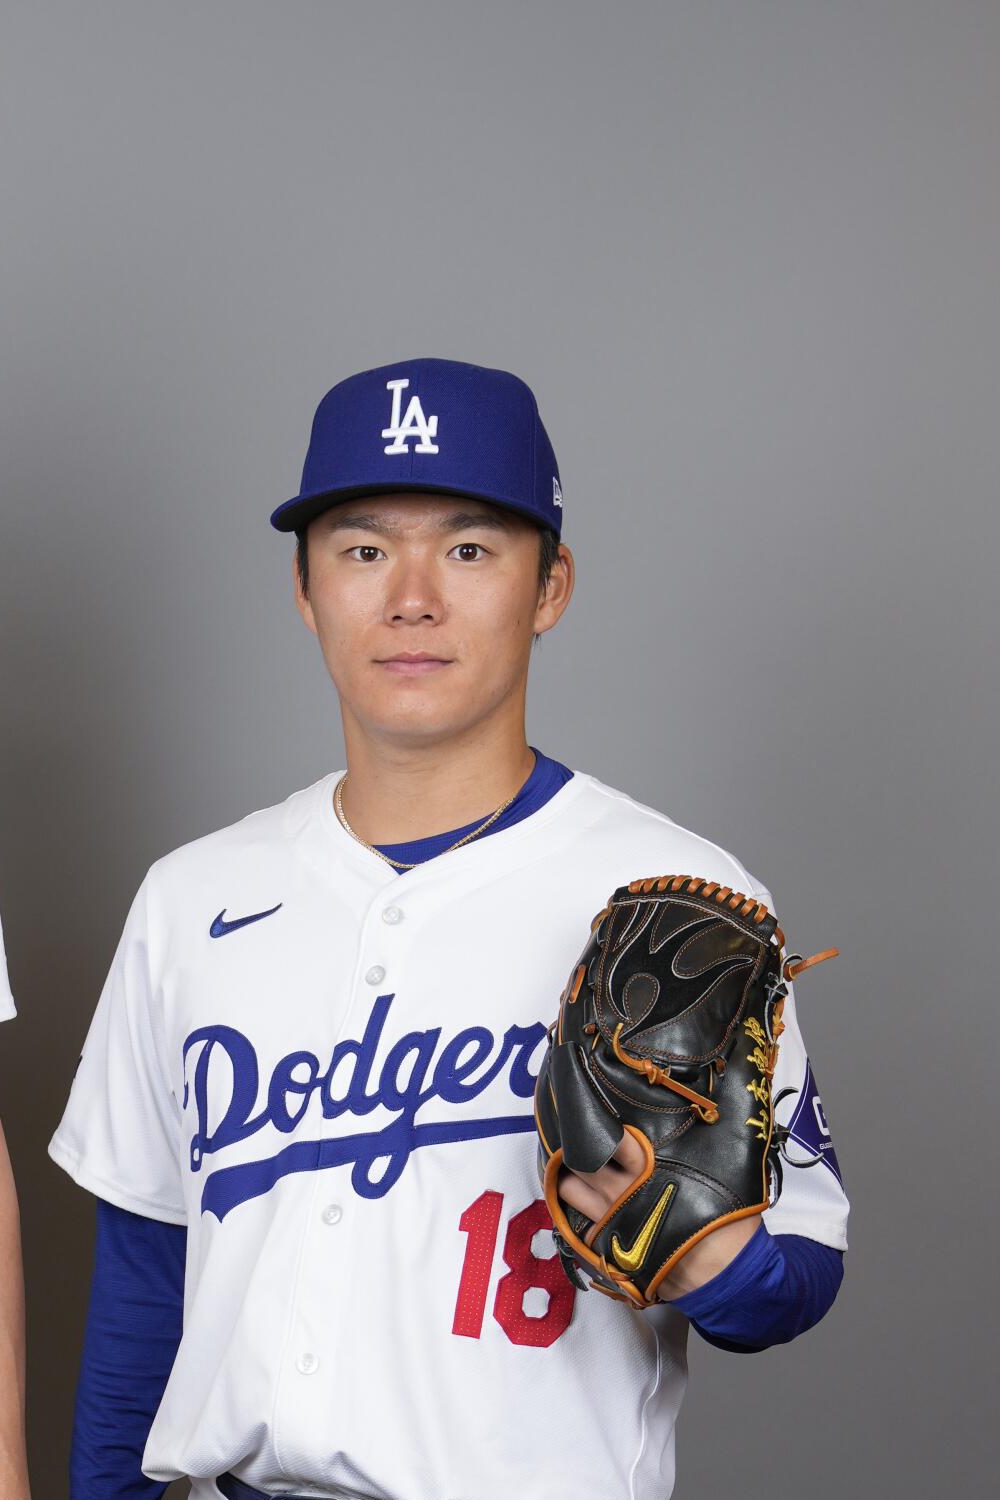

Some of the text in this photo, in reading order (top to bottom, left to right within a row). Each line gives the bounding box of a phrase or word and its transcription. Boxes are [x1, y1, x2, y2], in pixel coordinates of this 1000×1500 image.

[381, 378, 440, 455] LA
[183, 992, 549, 1200] Dodger
[452, 1188, 580, 1348] 18
